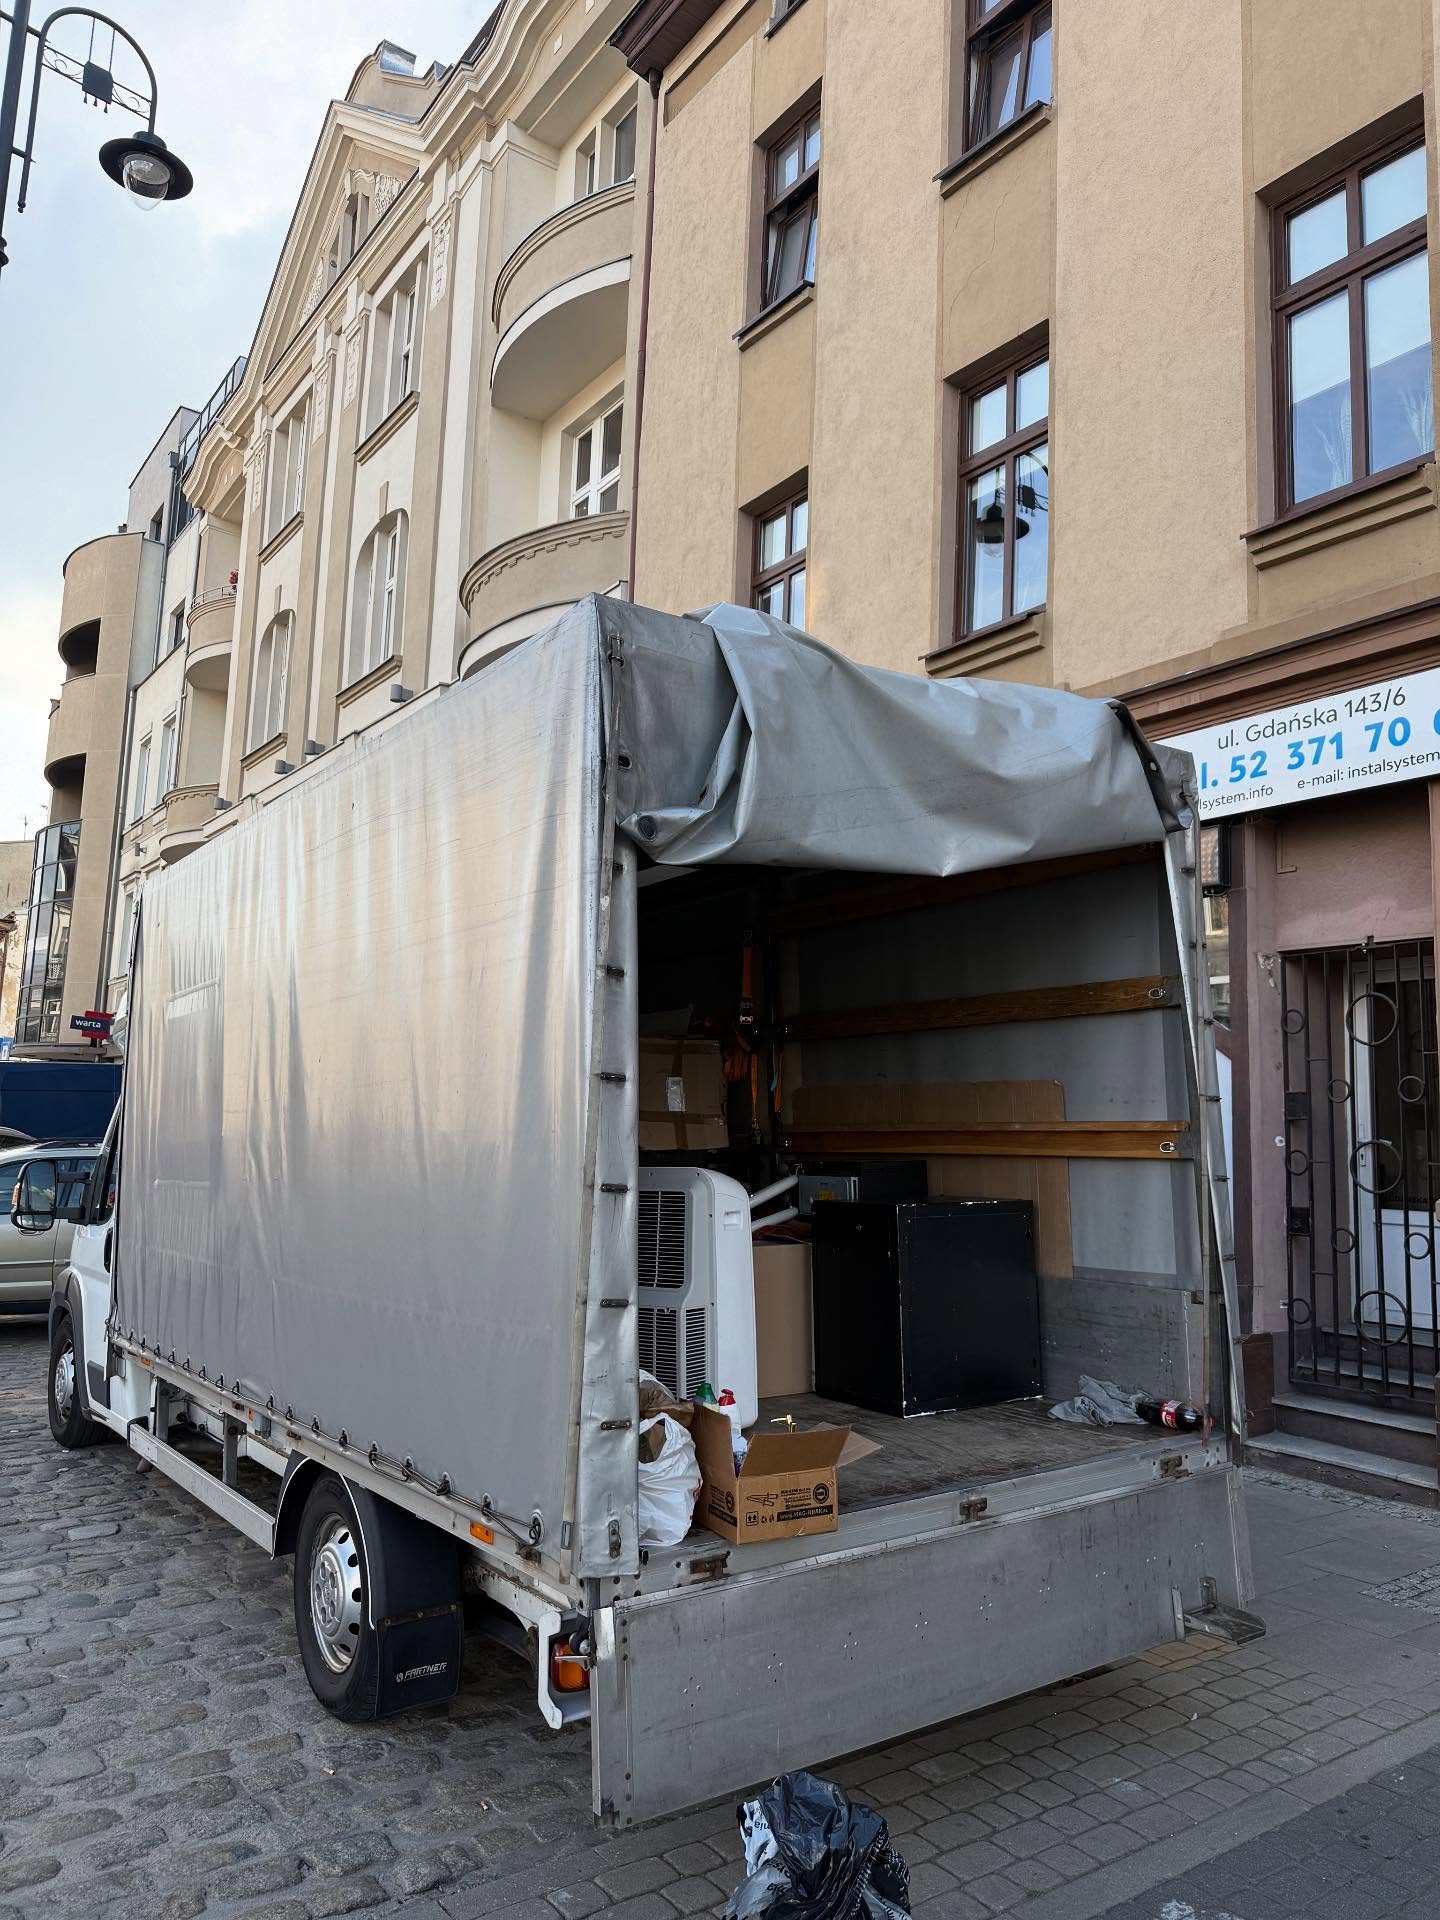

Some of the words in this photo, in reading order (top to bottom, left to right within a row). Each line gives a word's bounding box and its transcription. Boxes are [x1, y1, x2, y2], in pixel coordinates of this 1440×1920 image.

[1218, 729, 1239, 749] ul.
[1246, 708, 1338, 742] Gdańska
[1344, 686, 1406, 718] 143/6
[1229, 751, 1268, 783] 52
[1287, 732, 1343, 770] 371
[1364, 717, 1411, 752] 70
[1297, 770, 1344, 789] e-mail:
[75, 1019, 101, 1028] warta
[404, 1662, 447, 1679] PARTNER
